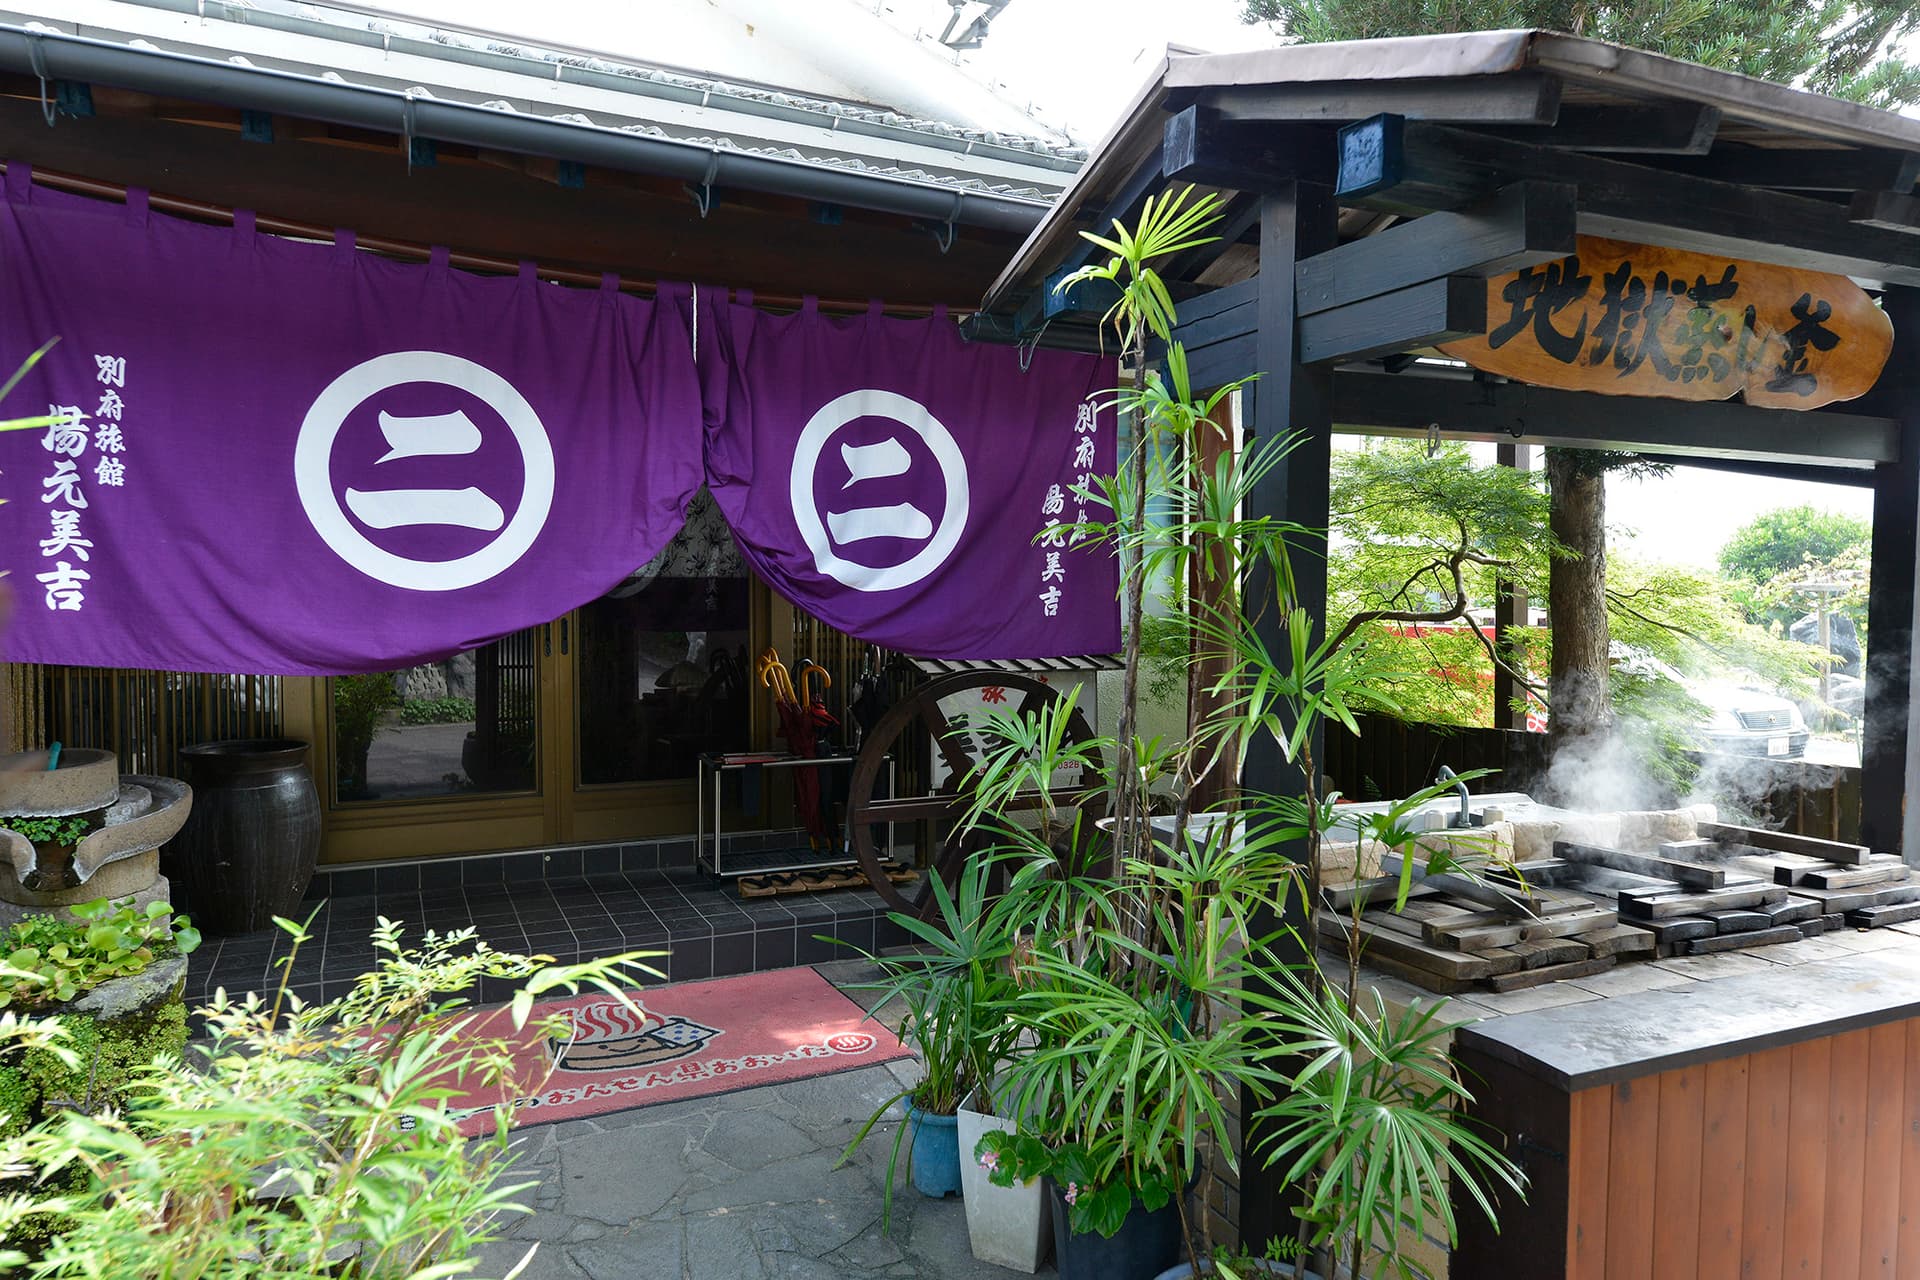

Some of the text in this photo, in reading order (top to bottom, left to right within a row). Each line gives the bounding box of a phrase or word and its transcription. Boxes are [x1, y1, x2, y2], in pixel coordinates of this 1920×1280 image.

[94, 353, 127, 487] 別府旅館
[35, 403, 94, 612] 湯元美吉
[1038, 482, 1066, 617] 湯元美吉
